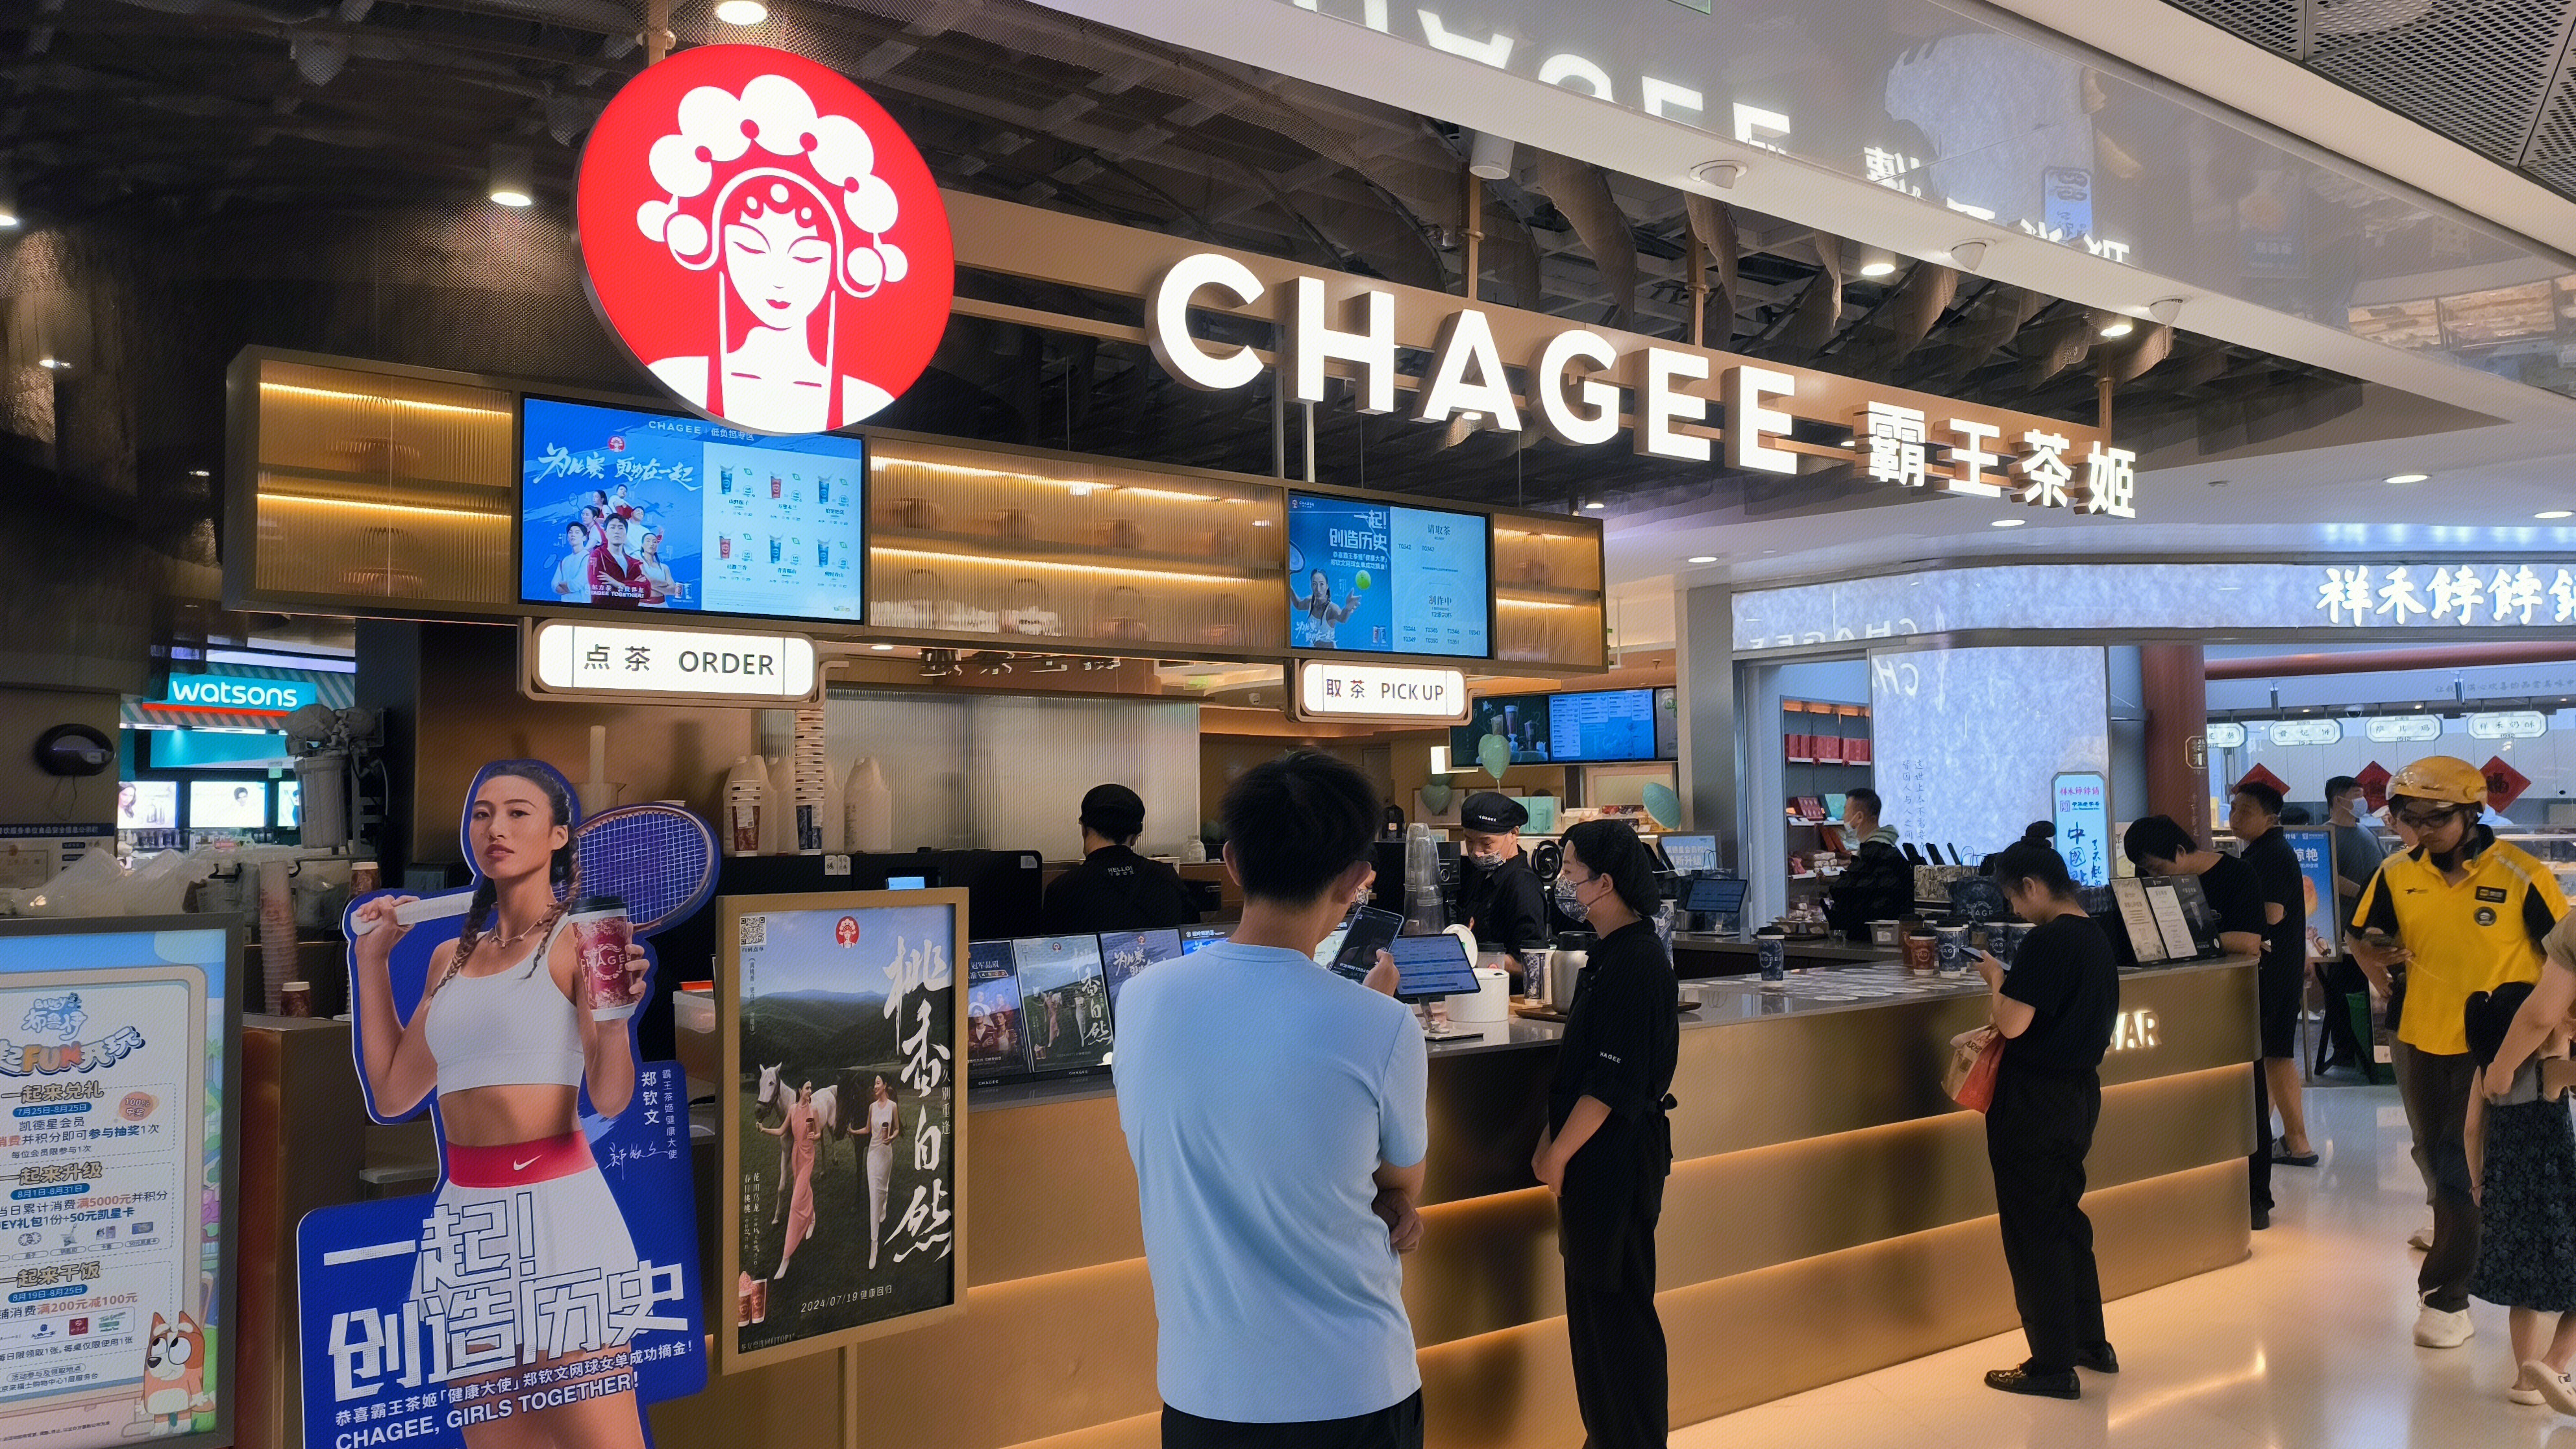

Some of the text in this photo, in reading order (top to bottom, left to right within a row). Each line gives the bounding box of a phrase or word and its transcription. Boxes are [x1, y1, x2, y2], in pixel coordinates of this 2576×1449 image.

[1156, 252, 1797, 475] CHAGEE
[649, 420, 701, 434] CHAGEE
[1867, 400, 2135, 519] 霸王茶姬
[1329, 528, 1387, 552] 创造历史
[1428, 524, 1451, 536] 请取茶
[1429, 595, 1452, 606] 制作中
[584, 644, 774, 676] 点茶 ORDER
[173, 681, 297, 708] watsons
[1326, 678, 1444, 701] 取茶 PICK UP
[1, 1080, 105, 1104] 一起来兑礼
[125, 1098, 151, 1107] 100%
[641, 1071, 660, 1126] 郑钦文
[19, 1117, 85, 1132] 凯德星会员
[126, 1108, 144, 1117] 中奖
[662, 1069, 678, 1159] 霸王茶姬健康大使
[0, 1161, 103, 1185] 一起来升级
[0, 1261, 101, 1288] 一起来干饭
[800, 1292, 858, 1313] 2024/07/19
[328, 1259, 689, 1403] 创造历史
[11, 1365, 82, 1381] 活动参与及领取地点
[335, 1372, 639, 1449] CHAGEE, GIRLS TOGETHER!
